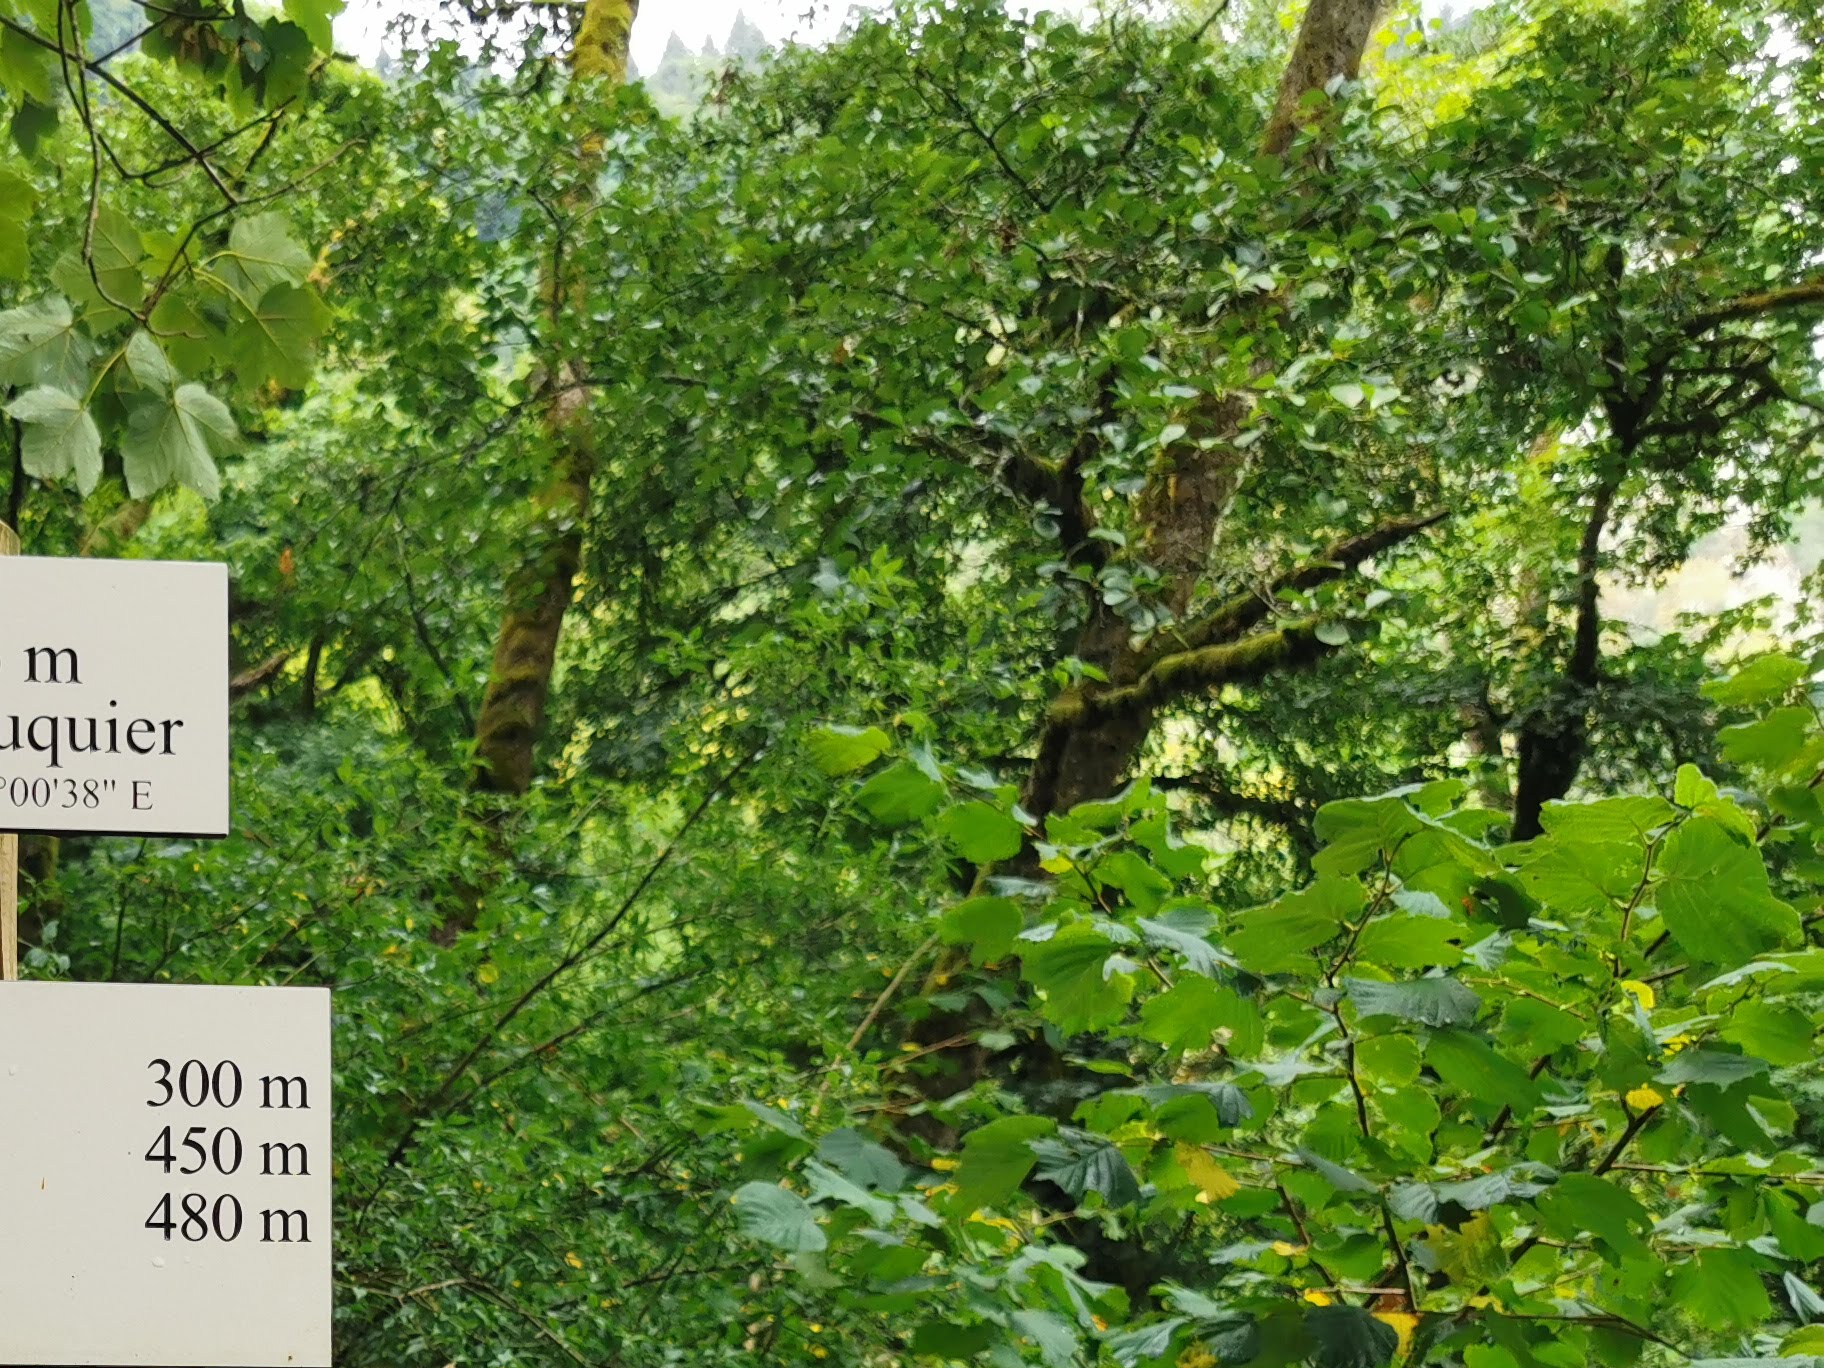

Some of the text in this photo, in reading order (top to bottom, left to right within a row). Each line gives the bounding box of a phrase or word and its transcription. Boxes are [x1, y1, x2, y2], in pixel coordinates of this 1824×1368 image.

[24, 647, 82, 684] m
[132, 781, 152, 810] E
[147, 1059, 311, 1108] 300 m
[145, 1126, 311, 1175] 450 m
[145, 1193, 312, 1242] 480 m
